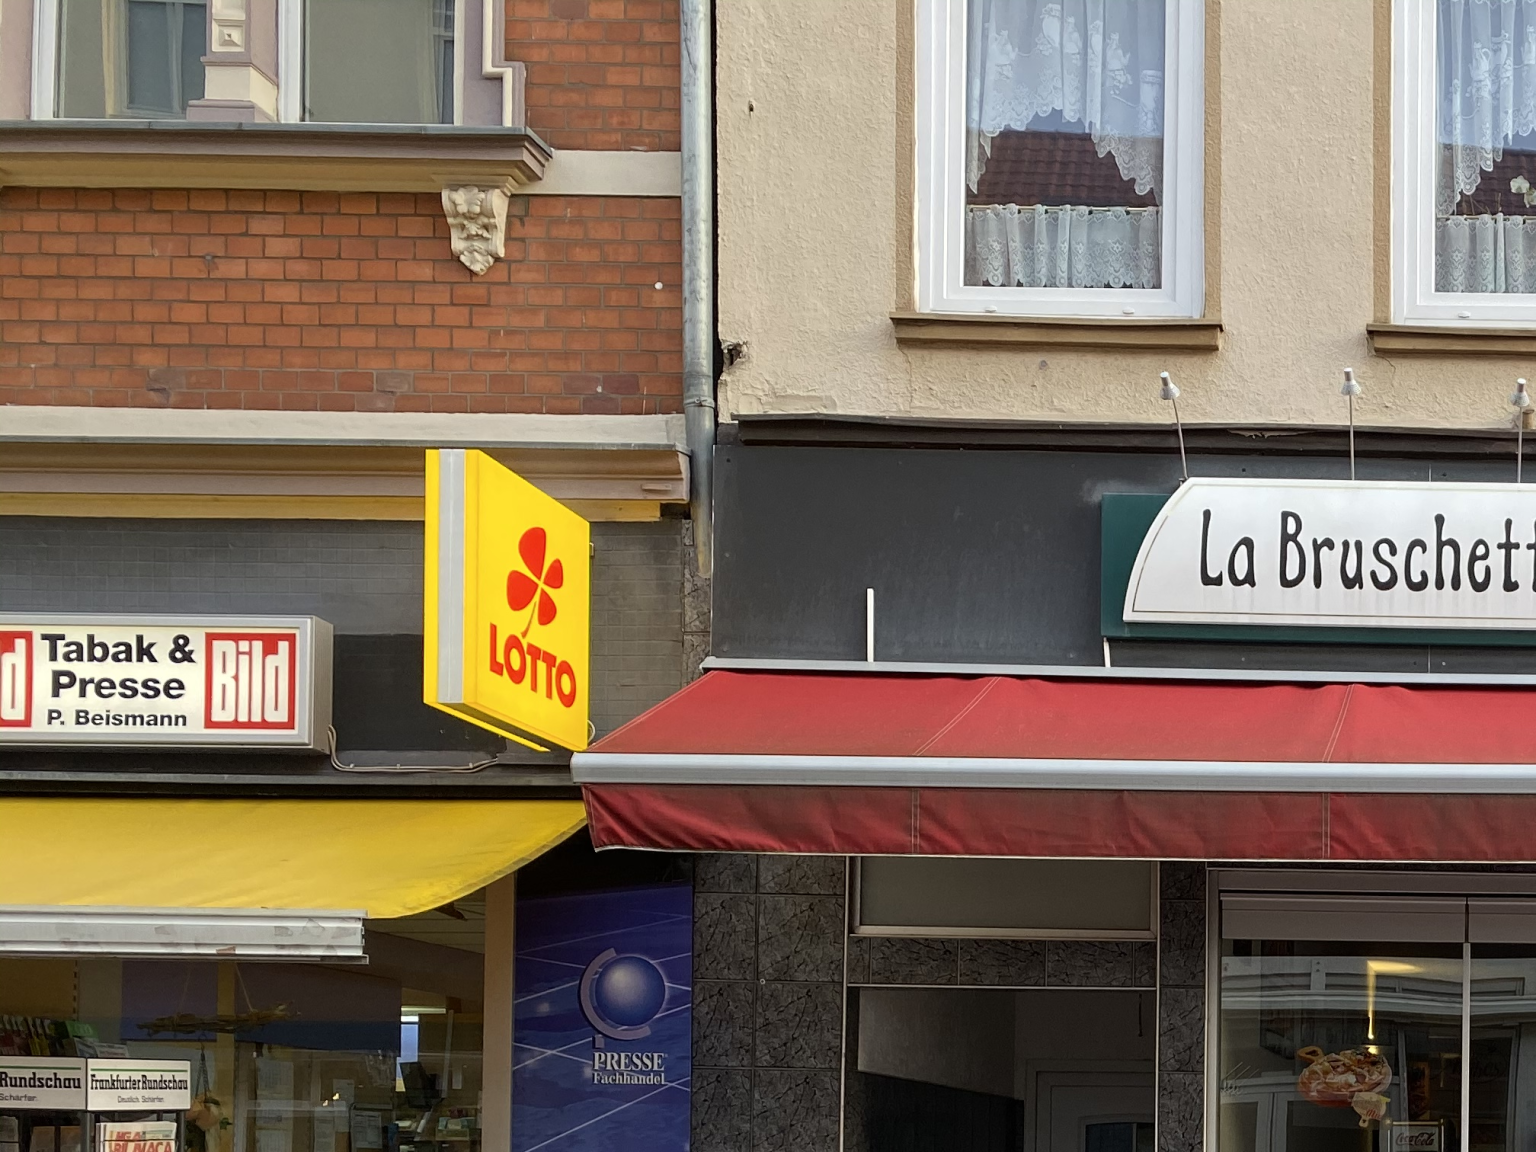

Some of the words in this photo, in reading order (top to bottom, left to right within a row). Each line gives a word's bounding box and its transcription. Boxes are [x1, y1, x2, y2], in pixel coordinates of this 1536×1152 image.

[1200, 509, 1256, 588] La
[41, 633, 159, 663] Tabak
[168, 634, 196, 663] &
[490, 622, 577, 708] LOTTO
[51, 669, 186, 699] Presse
[210, 639, 290, 723] Bild
[47, 709, 65, 725] P.
[74, 709, 188, 726] Beismann
[592, 1051, 665, 1071] PRESSE
[0, 1071, 82, 1090] Rundschau
[90, 1073, 141, 1091] Frankfurter
[141, 1074, 189, 1091] Rundschau
[592, 1072, 665, 1085] Fachhandel
